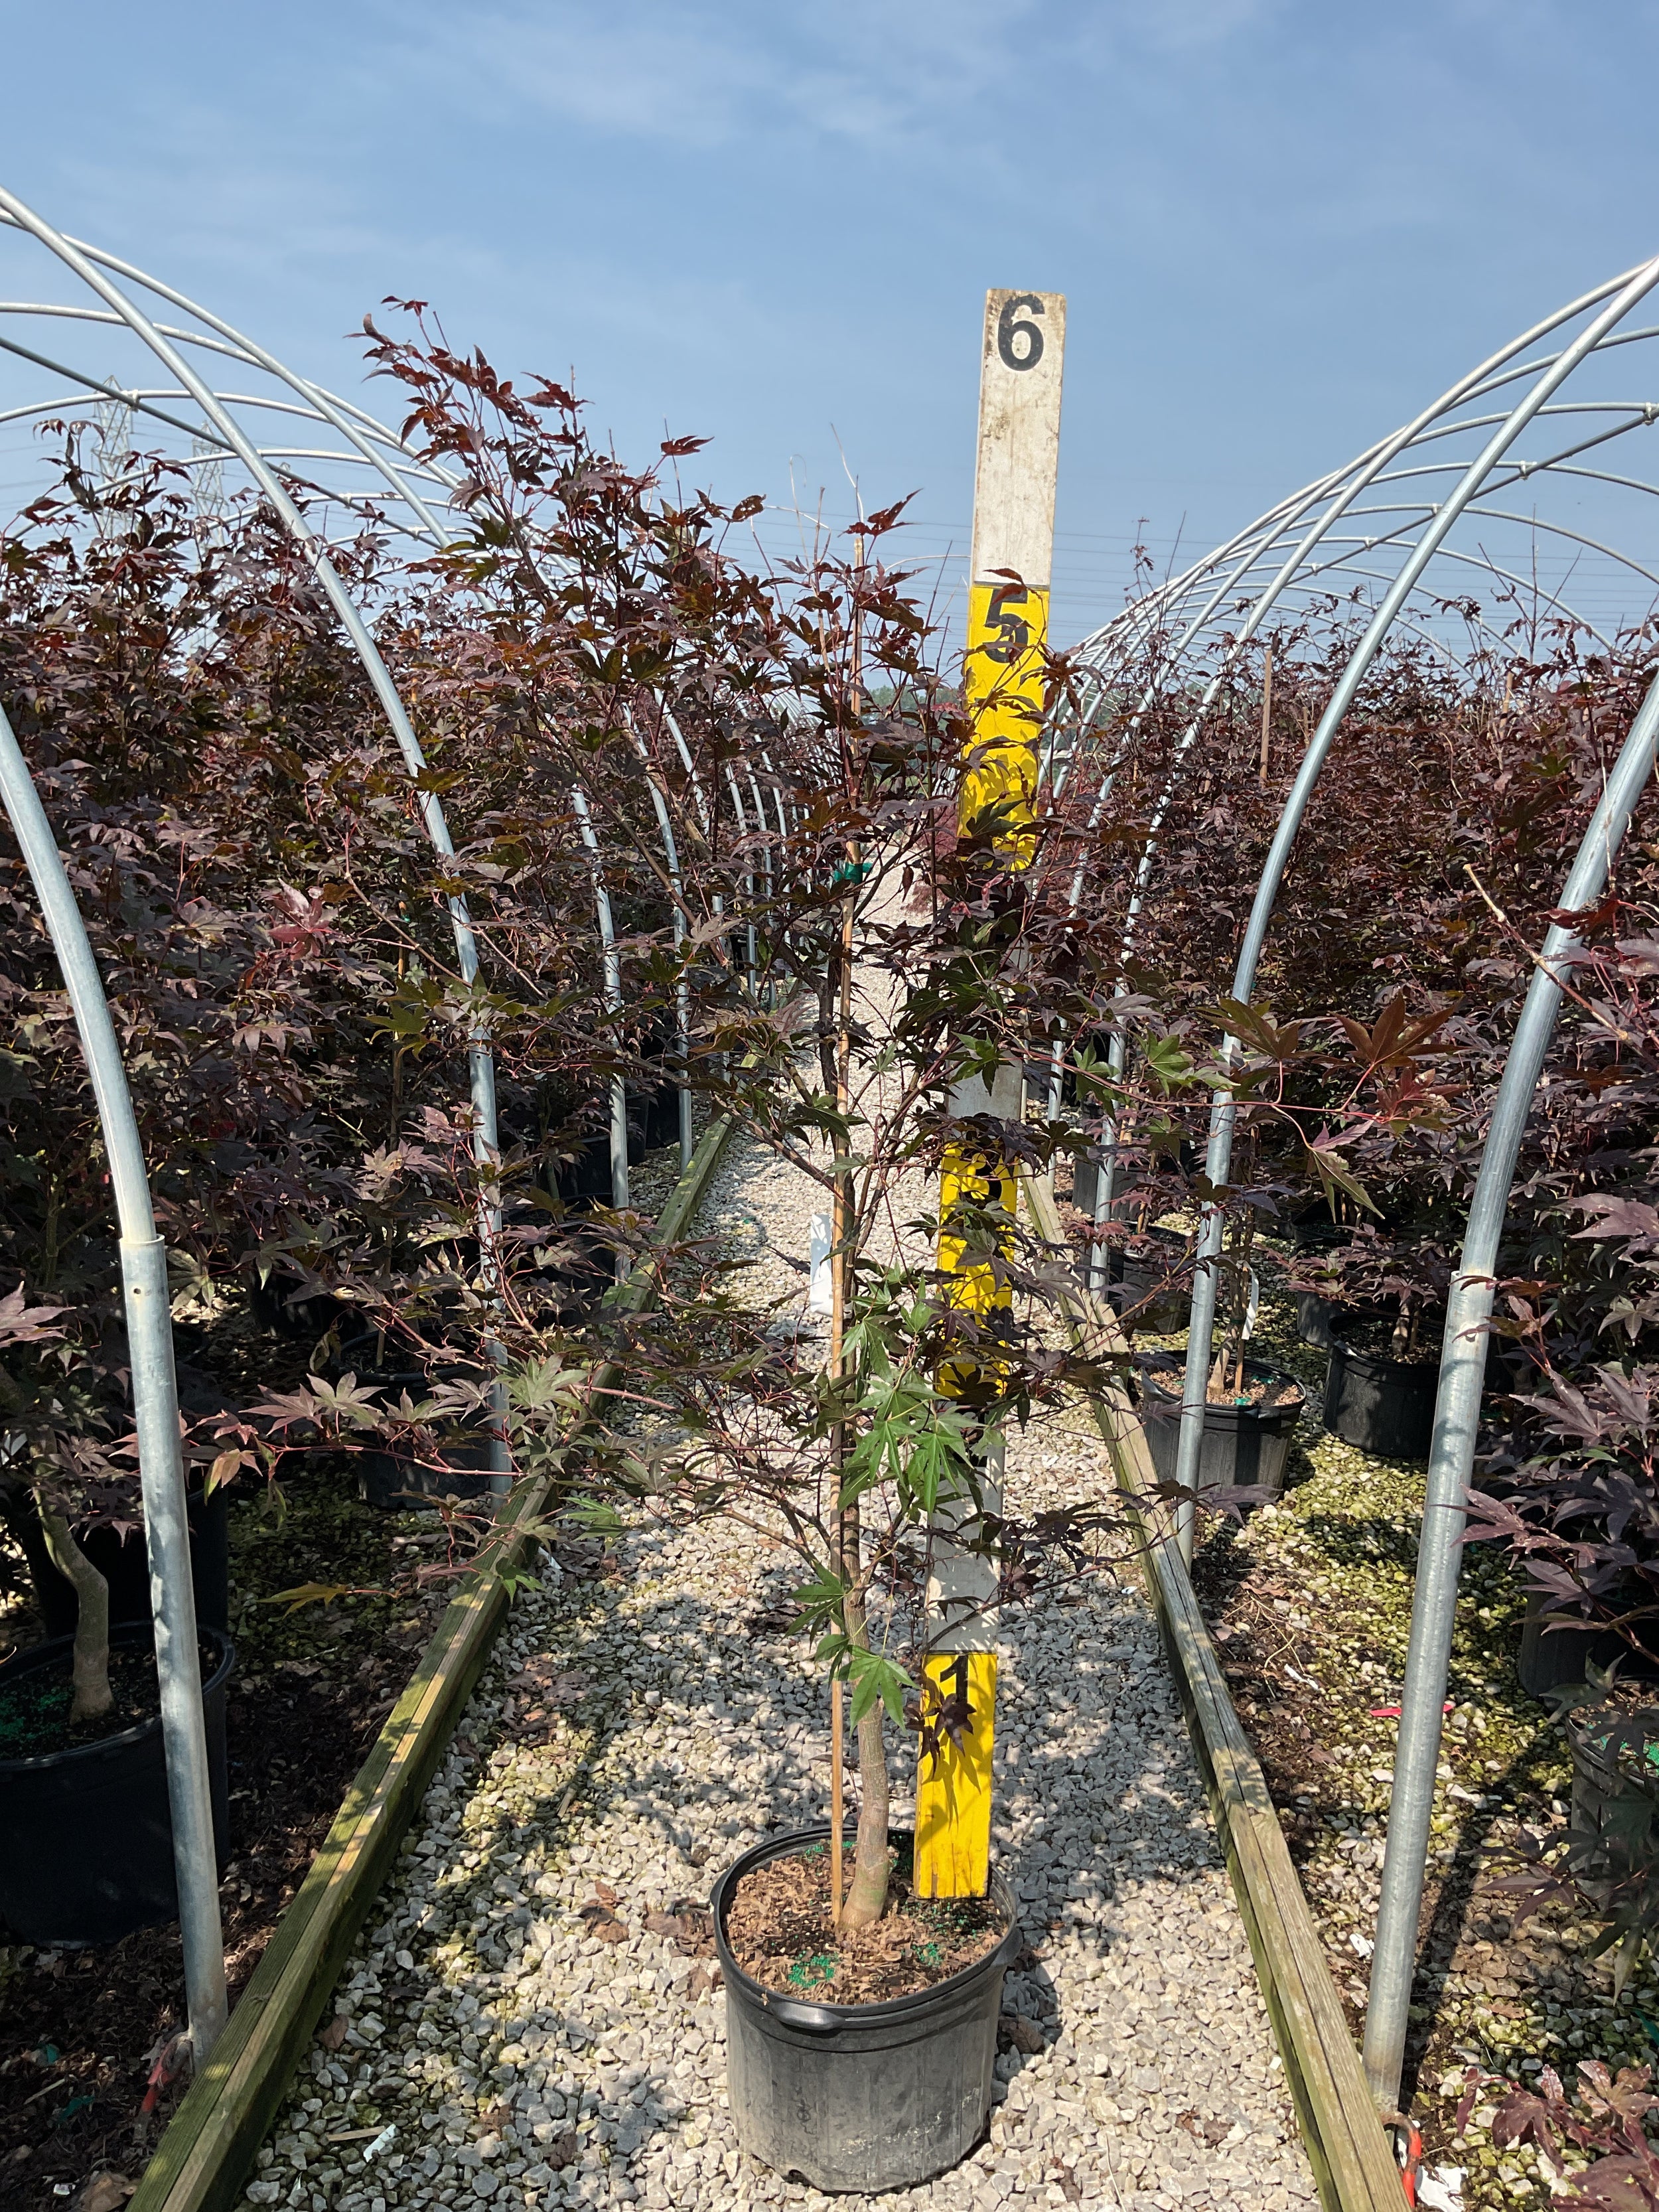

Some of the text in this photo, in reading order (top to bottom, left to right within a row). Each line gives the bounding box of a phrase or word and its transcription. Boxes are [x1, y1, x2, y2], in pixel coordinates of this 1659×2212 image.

[997, 294, 1045, 372] 6
[983, 587, 1029, 664] 5
[940, 1655, 969, 1720] 1
